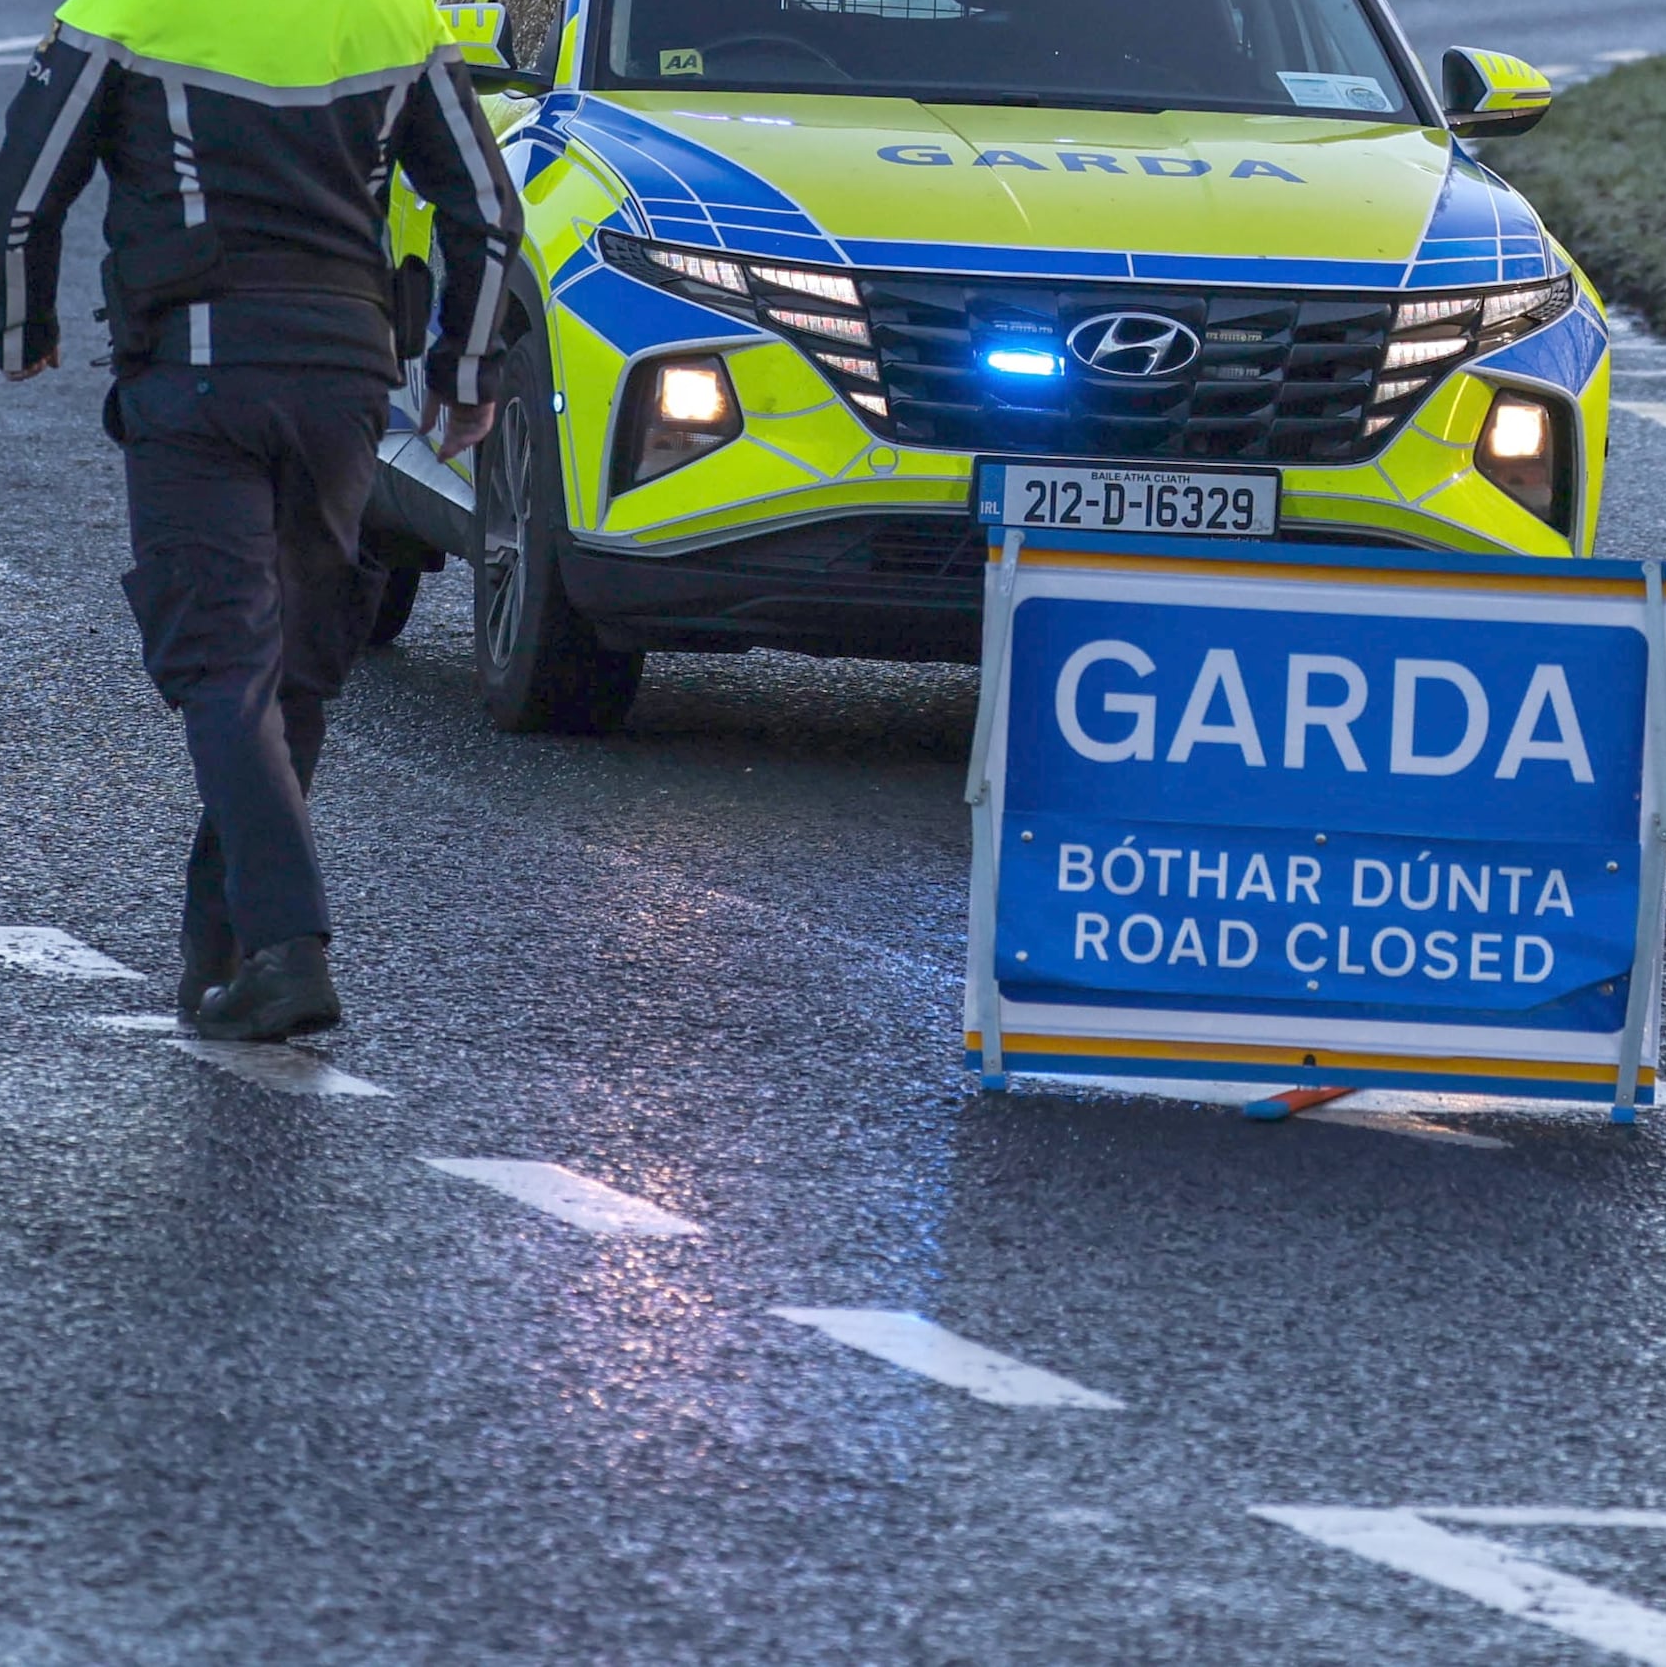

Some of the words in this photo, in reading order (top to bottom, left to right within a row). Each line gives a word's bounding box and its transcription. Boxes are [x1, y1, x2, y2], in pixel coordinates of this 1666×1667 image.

[664, 54, 698, 70] AA
[876, 144, 1309, 184] GARDA
[1090, 471, 1122, 481] BAILE
[1153, 474, 1191, 484] CLIATH
[980, 500, 1001, 514] IRL
[1023, 480, 1254, 531] 212-D-16329
[1054, 639, 1595, 784] GARDA
[1057, 835, 1323, 905] BÓTHAR
[1351, 850, 1575, 919] DÚNTA
[1074, 911, 1259, 969] ROAD
[1285, 921, 1555, 984] CLOSED
